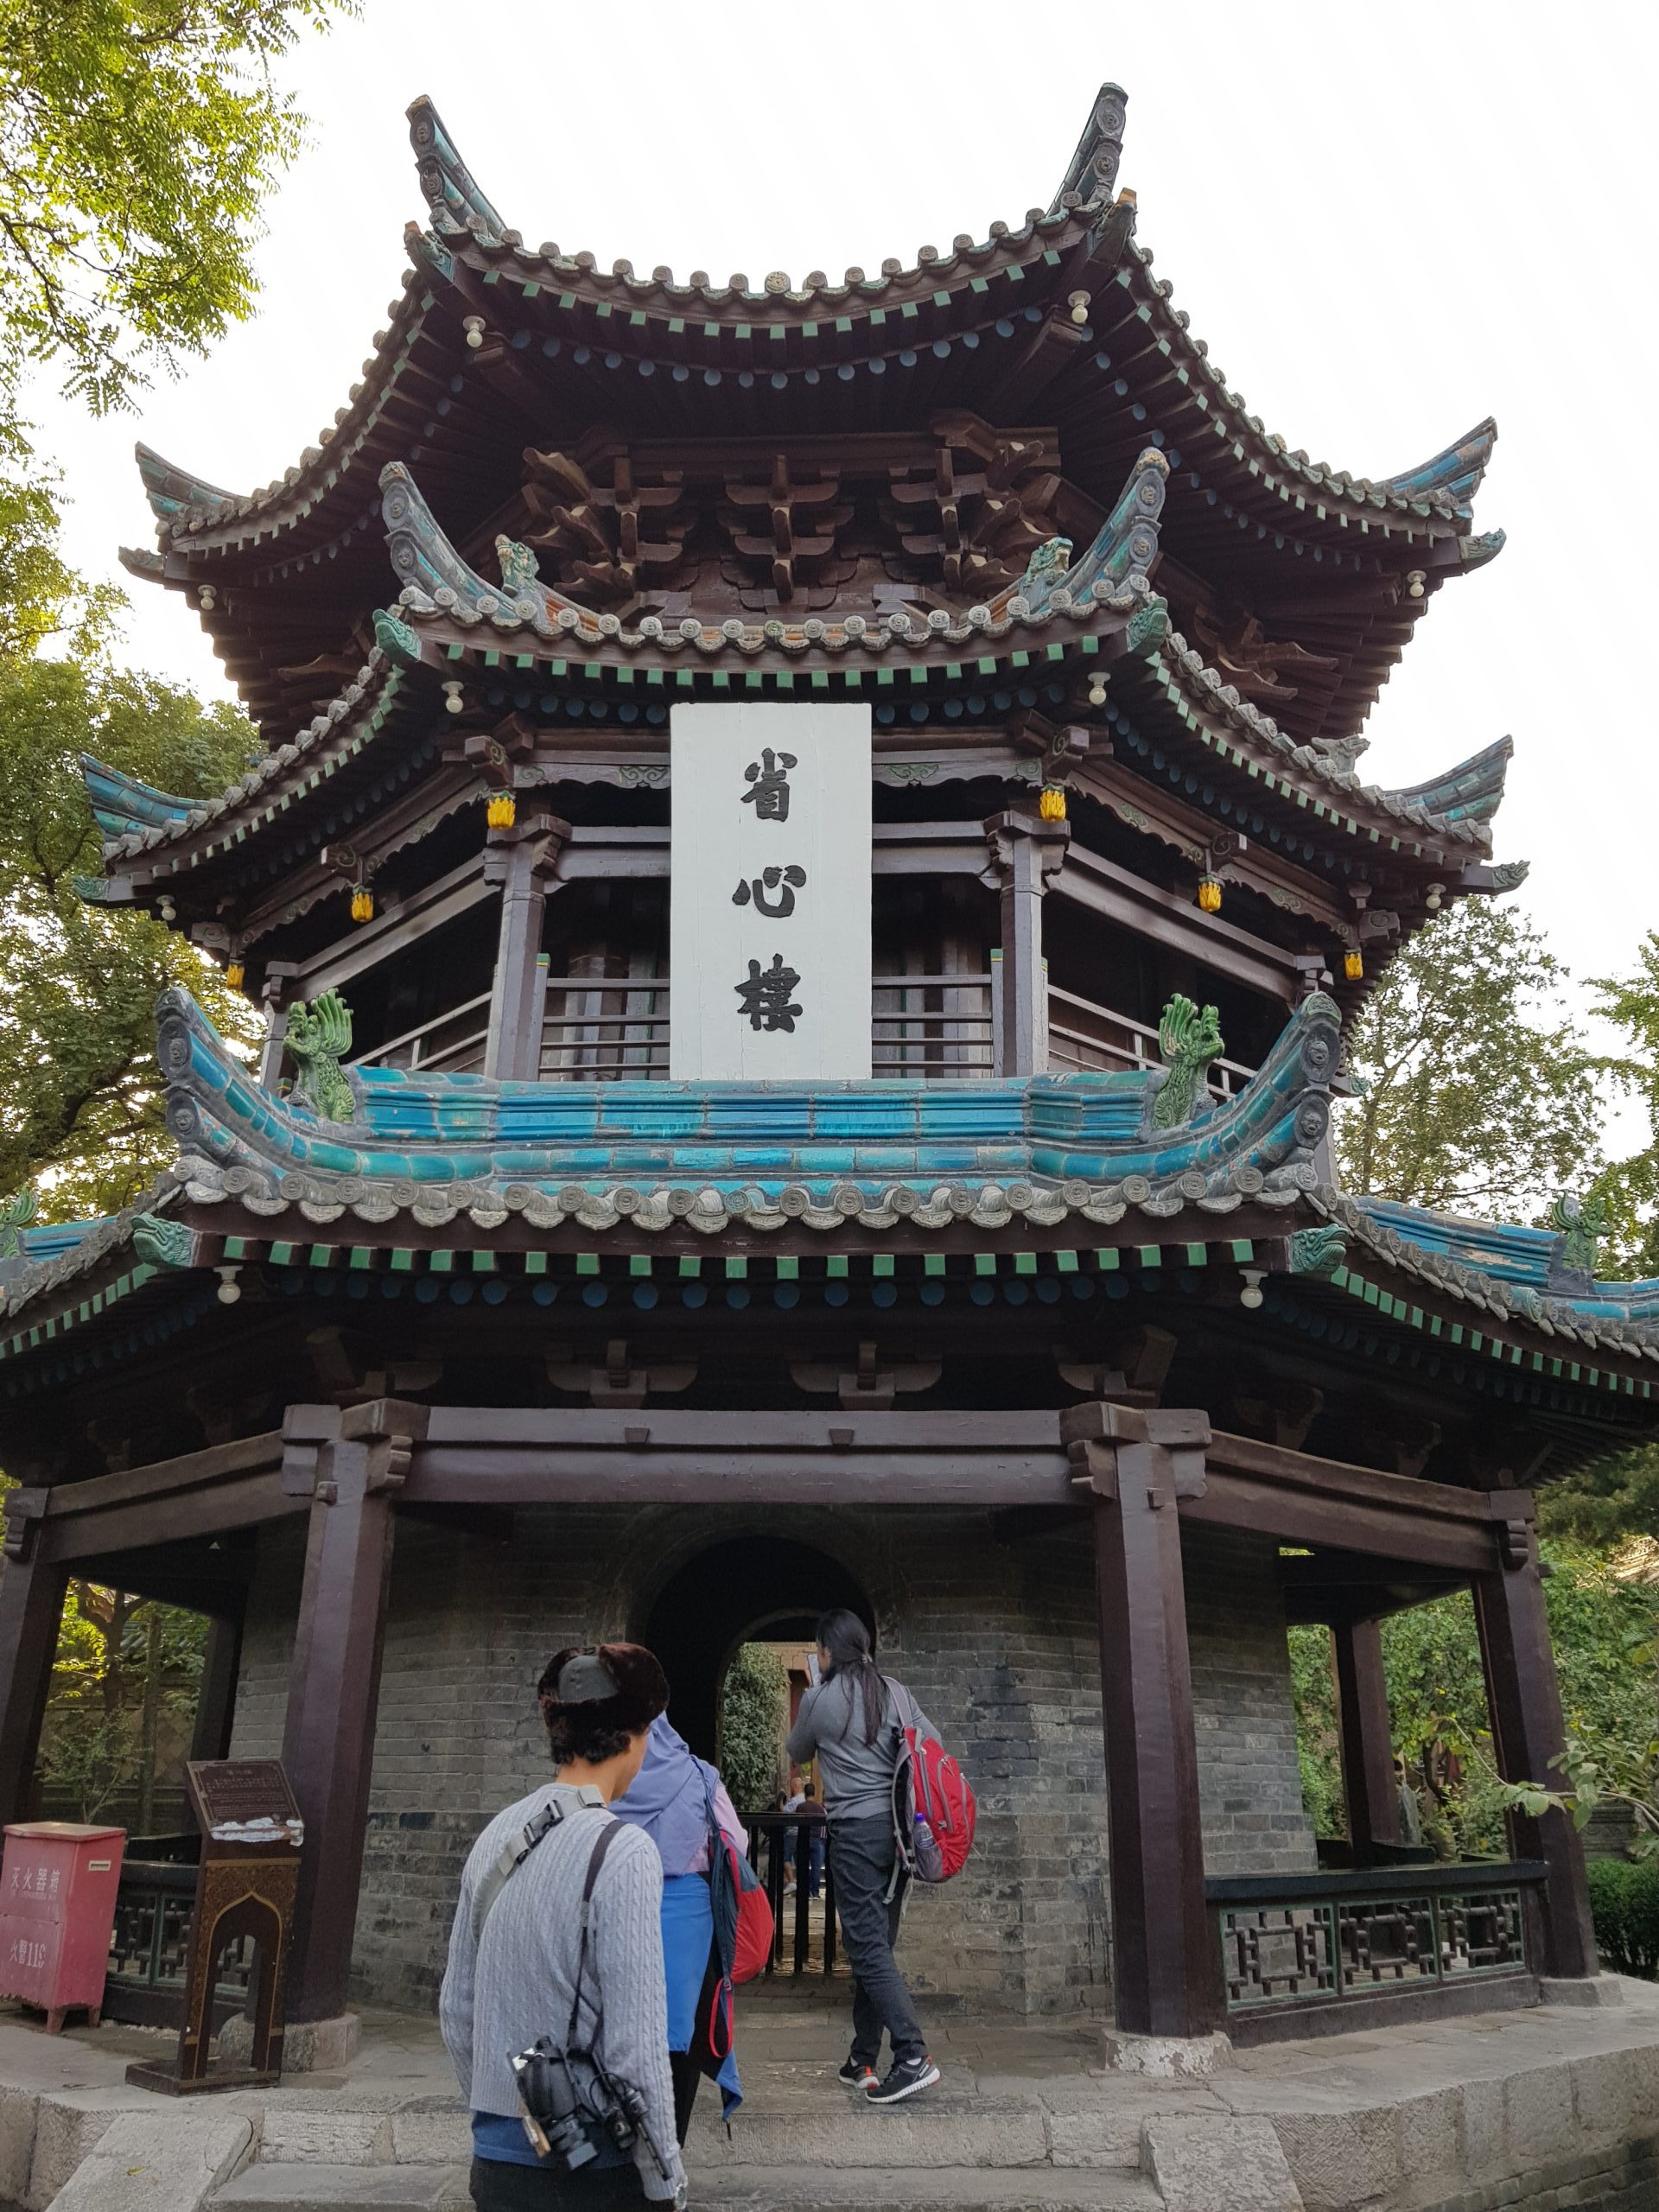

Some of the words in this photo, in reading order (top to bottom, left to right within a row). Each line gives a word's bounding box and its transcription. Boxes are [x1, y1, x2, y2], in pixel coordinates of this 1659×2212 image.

[732, 747, 807, 1033] 省心樓
[10, 1866, 60, 1893] 灭火器箱
